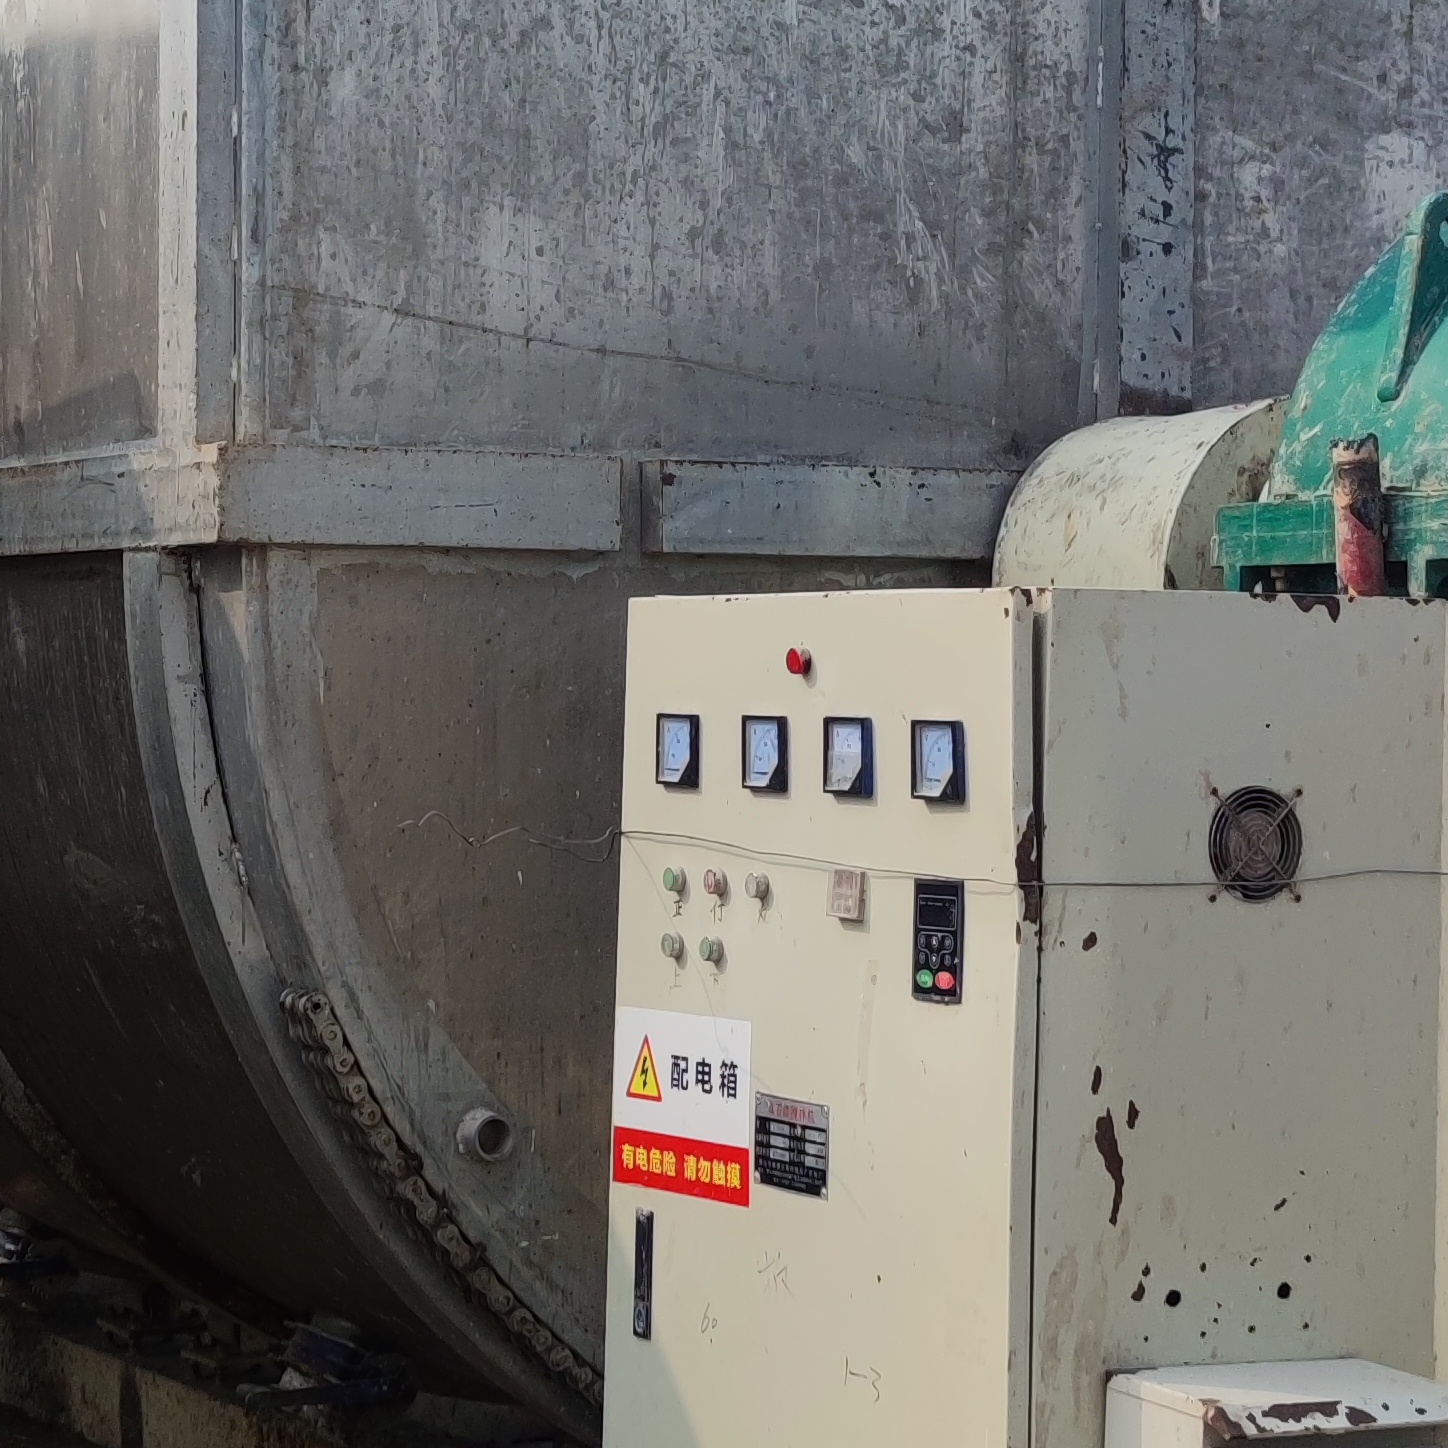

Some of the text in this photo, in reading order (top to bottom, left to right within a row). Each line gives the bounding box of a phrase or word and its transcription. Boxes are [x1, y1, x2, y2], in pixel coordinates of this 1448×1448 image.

[671, 1055, 739, 1100] 配电箱
[621, 1143, 677, 1177] 有电危险
[683, 1153, 742, 1190] 请勿触摸
